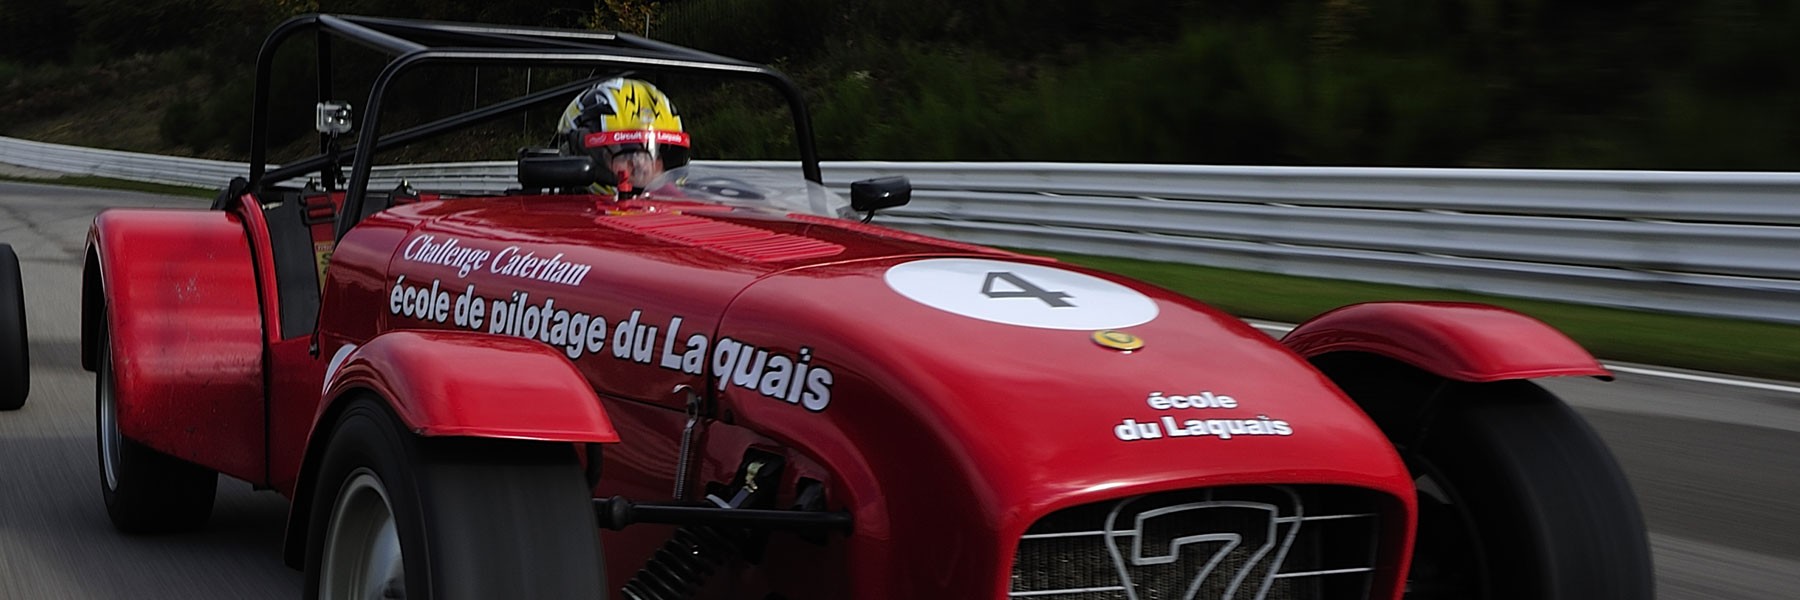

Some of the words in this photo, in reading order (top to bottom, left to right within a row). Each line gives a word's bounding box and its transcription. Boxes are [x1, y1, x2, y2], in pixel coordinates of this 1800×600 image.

[613, 131, 642, 141] Circuit
[404, 234, 491, 278] Challenge
[490, 245, 592, 286] Caterham
[981, 271, 1077, 308] 4
[390, 275, 449, 323] école
[454, 284, 485, 330] de
[489, 290, 606, 358] pilotage
[612, 309, 658, 362] du
[1147, 392, 1238, 410] école
[1114, 419, 1163, 441] du
[1160, 416, 1293, 440] Laquais
